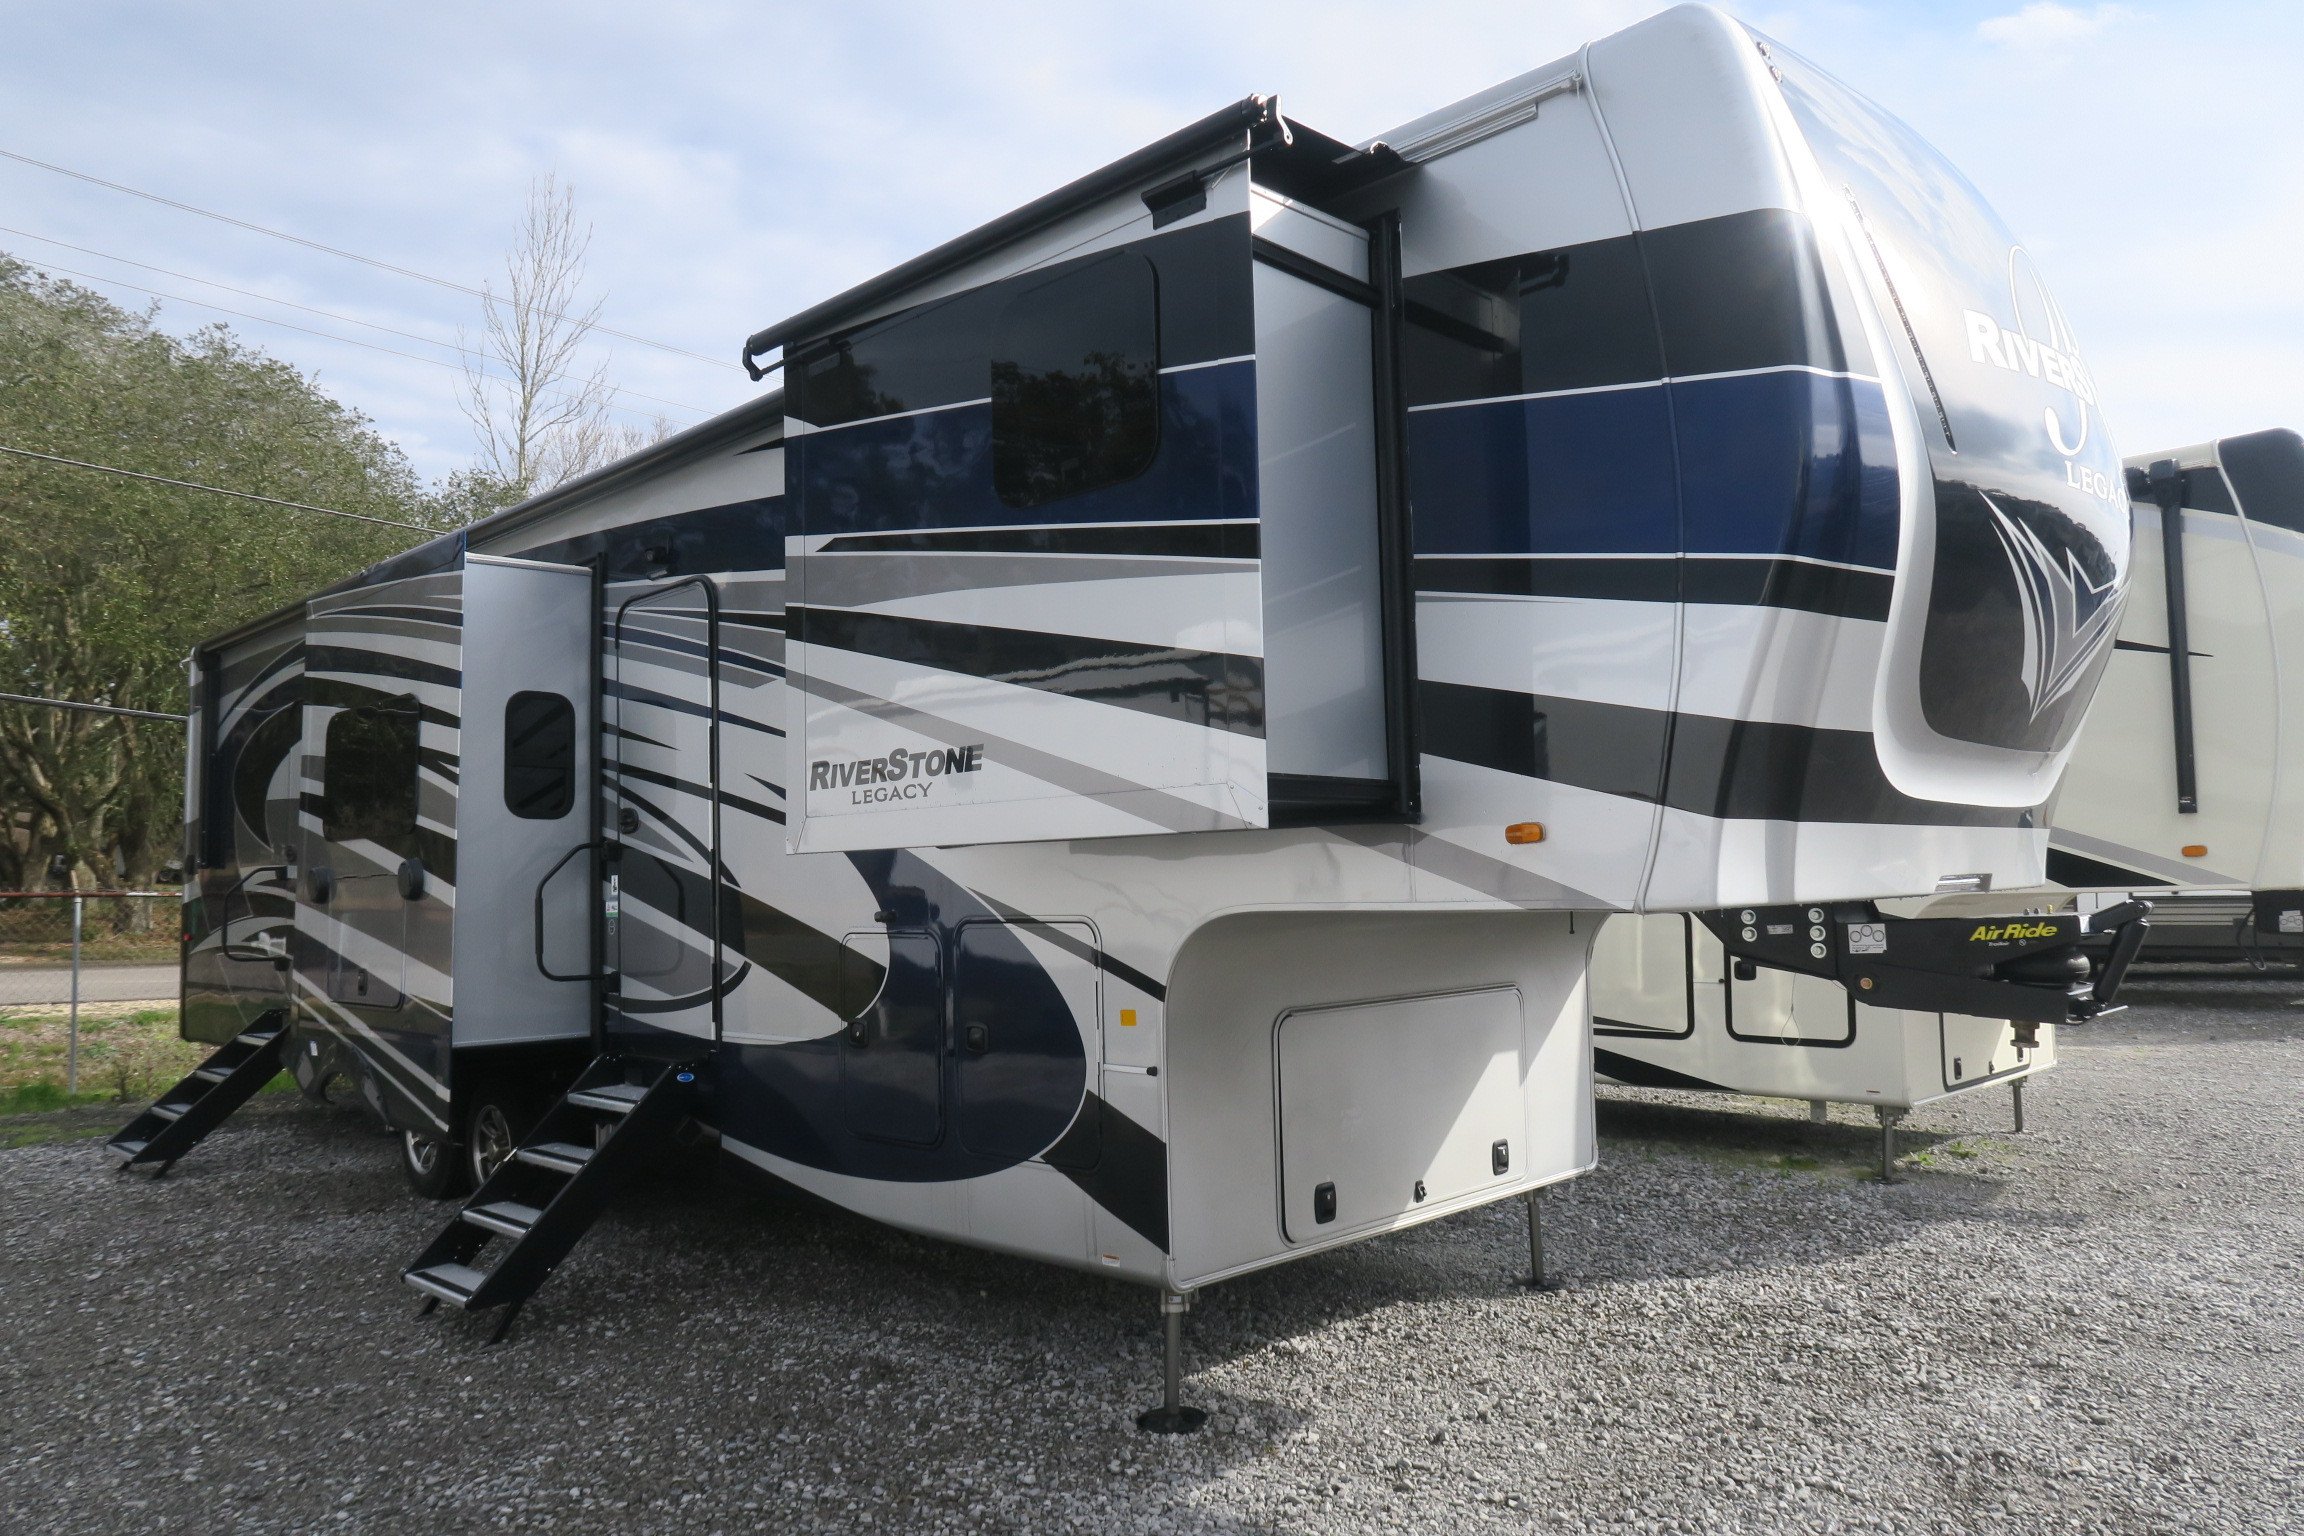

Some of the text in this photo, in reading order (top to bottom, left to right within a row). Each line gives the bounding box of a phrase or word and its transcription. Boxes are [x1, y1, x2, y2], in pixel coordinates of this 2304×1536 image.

[1962, 308, 2096, 406] RIVERS
[809, 744, 984, 791] RIVERSTONE
[851, 782, 933, 805] LEGACY
